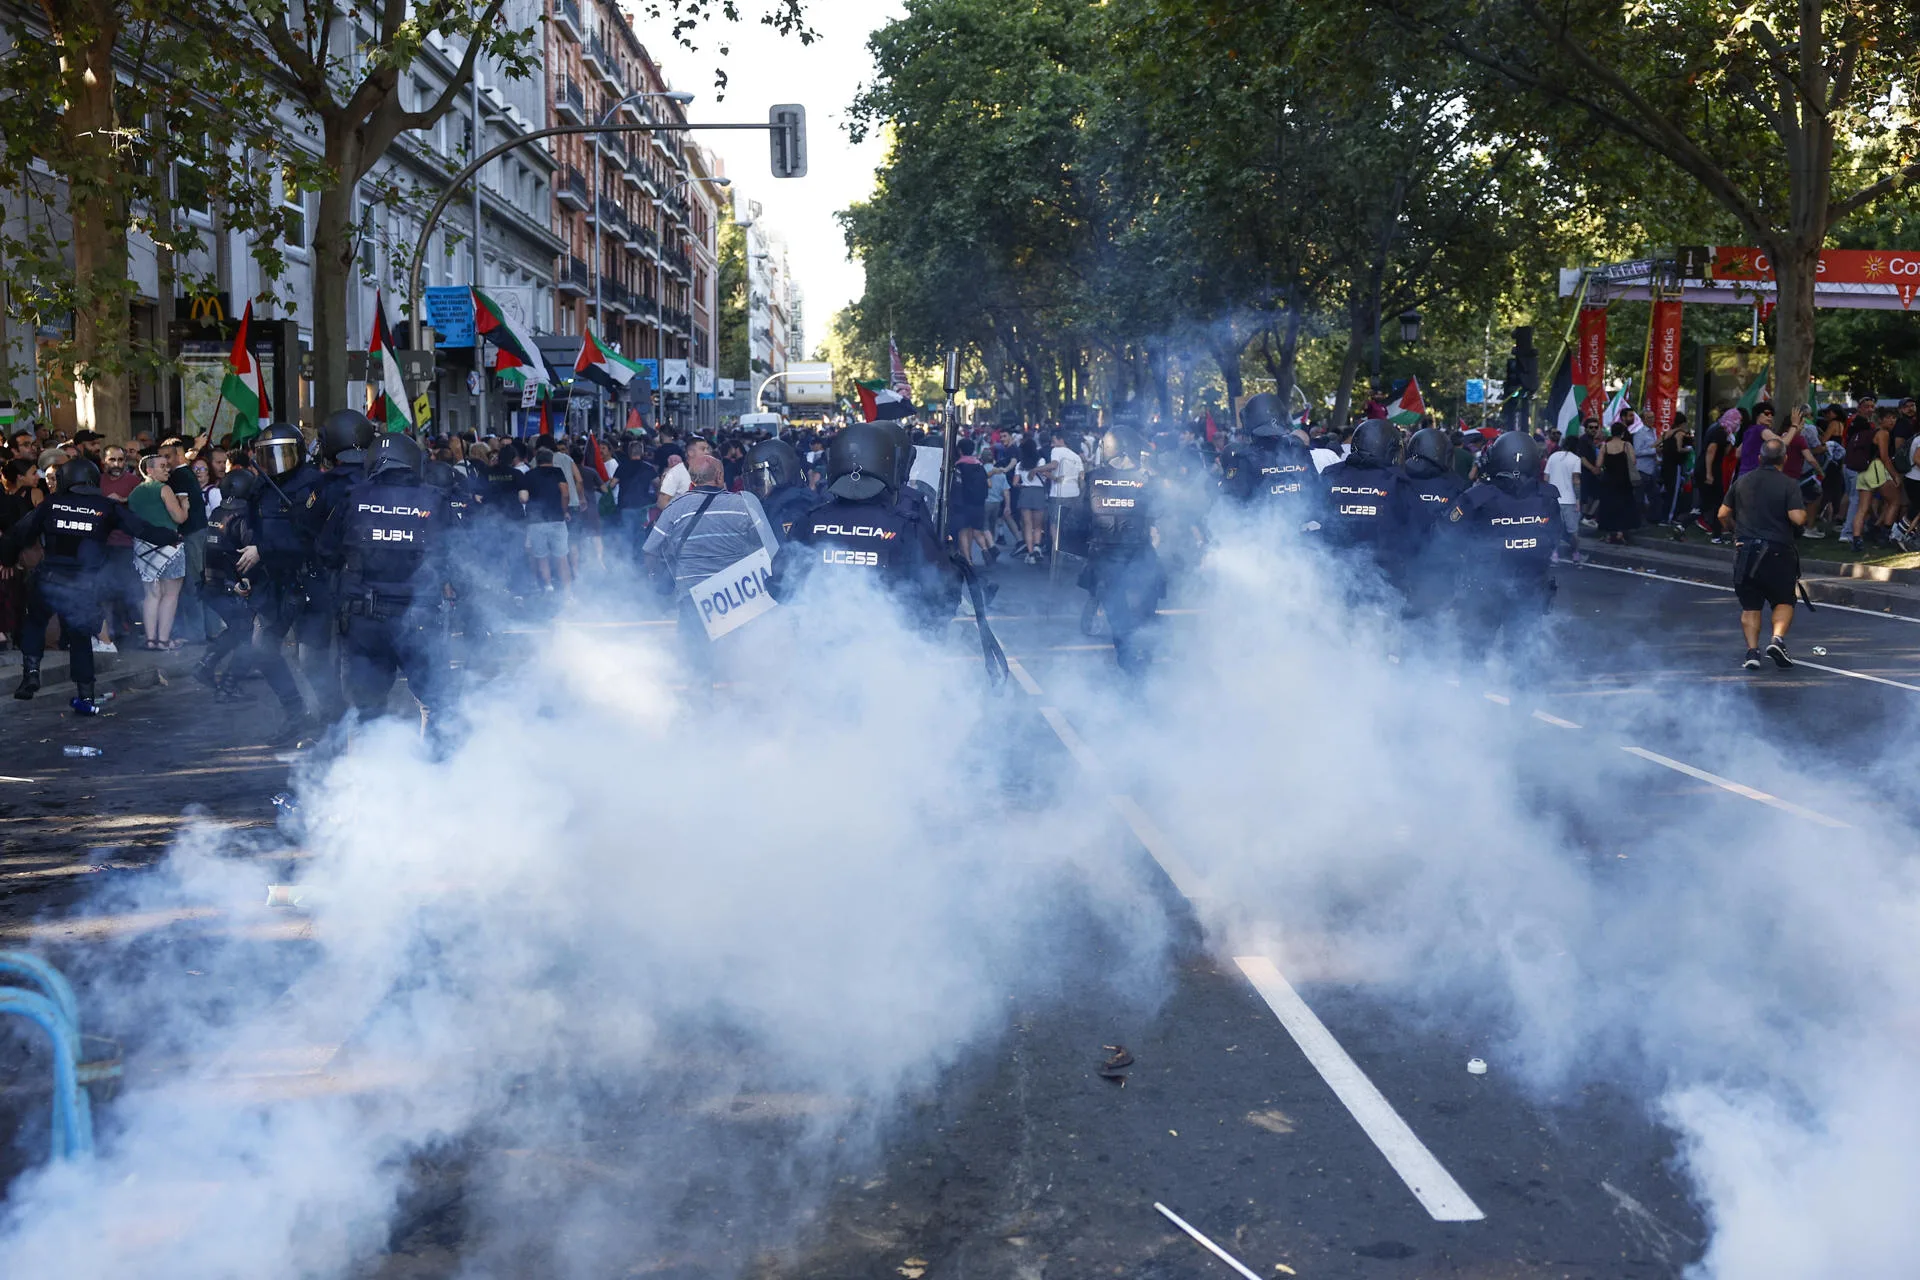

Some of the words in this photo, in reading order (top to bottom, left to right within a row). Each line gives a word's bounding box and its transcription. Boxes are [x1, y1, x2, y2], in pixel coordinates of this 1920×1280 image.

[1889, 257, 1920, 275] Co
[1589, 334, 1599, 375] Cofidis
[1662, 327, 1675, 372] Cofidis
[1660, 398, 1671, 435] ofidis
[1262, 465, 1303, 475] POLICIA
[1094, 479, 1137, 488] POLICIA
[1331, 486, 1380, 495] POLICIA
[52, 503, 97, 515] POLICIA
[358, 504, 421, 516] POLICIA
[1491, 515, 1542, 526] POLICIA
[813, 524, 884, 537] POLICIA
[823, 549, 878, 566] UC253
[699, 566, 771, 623] POLICIA
